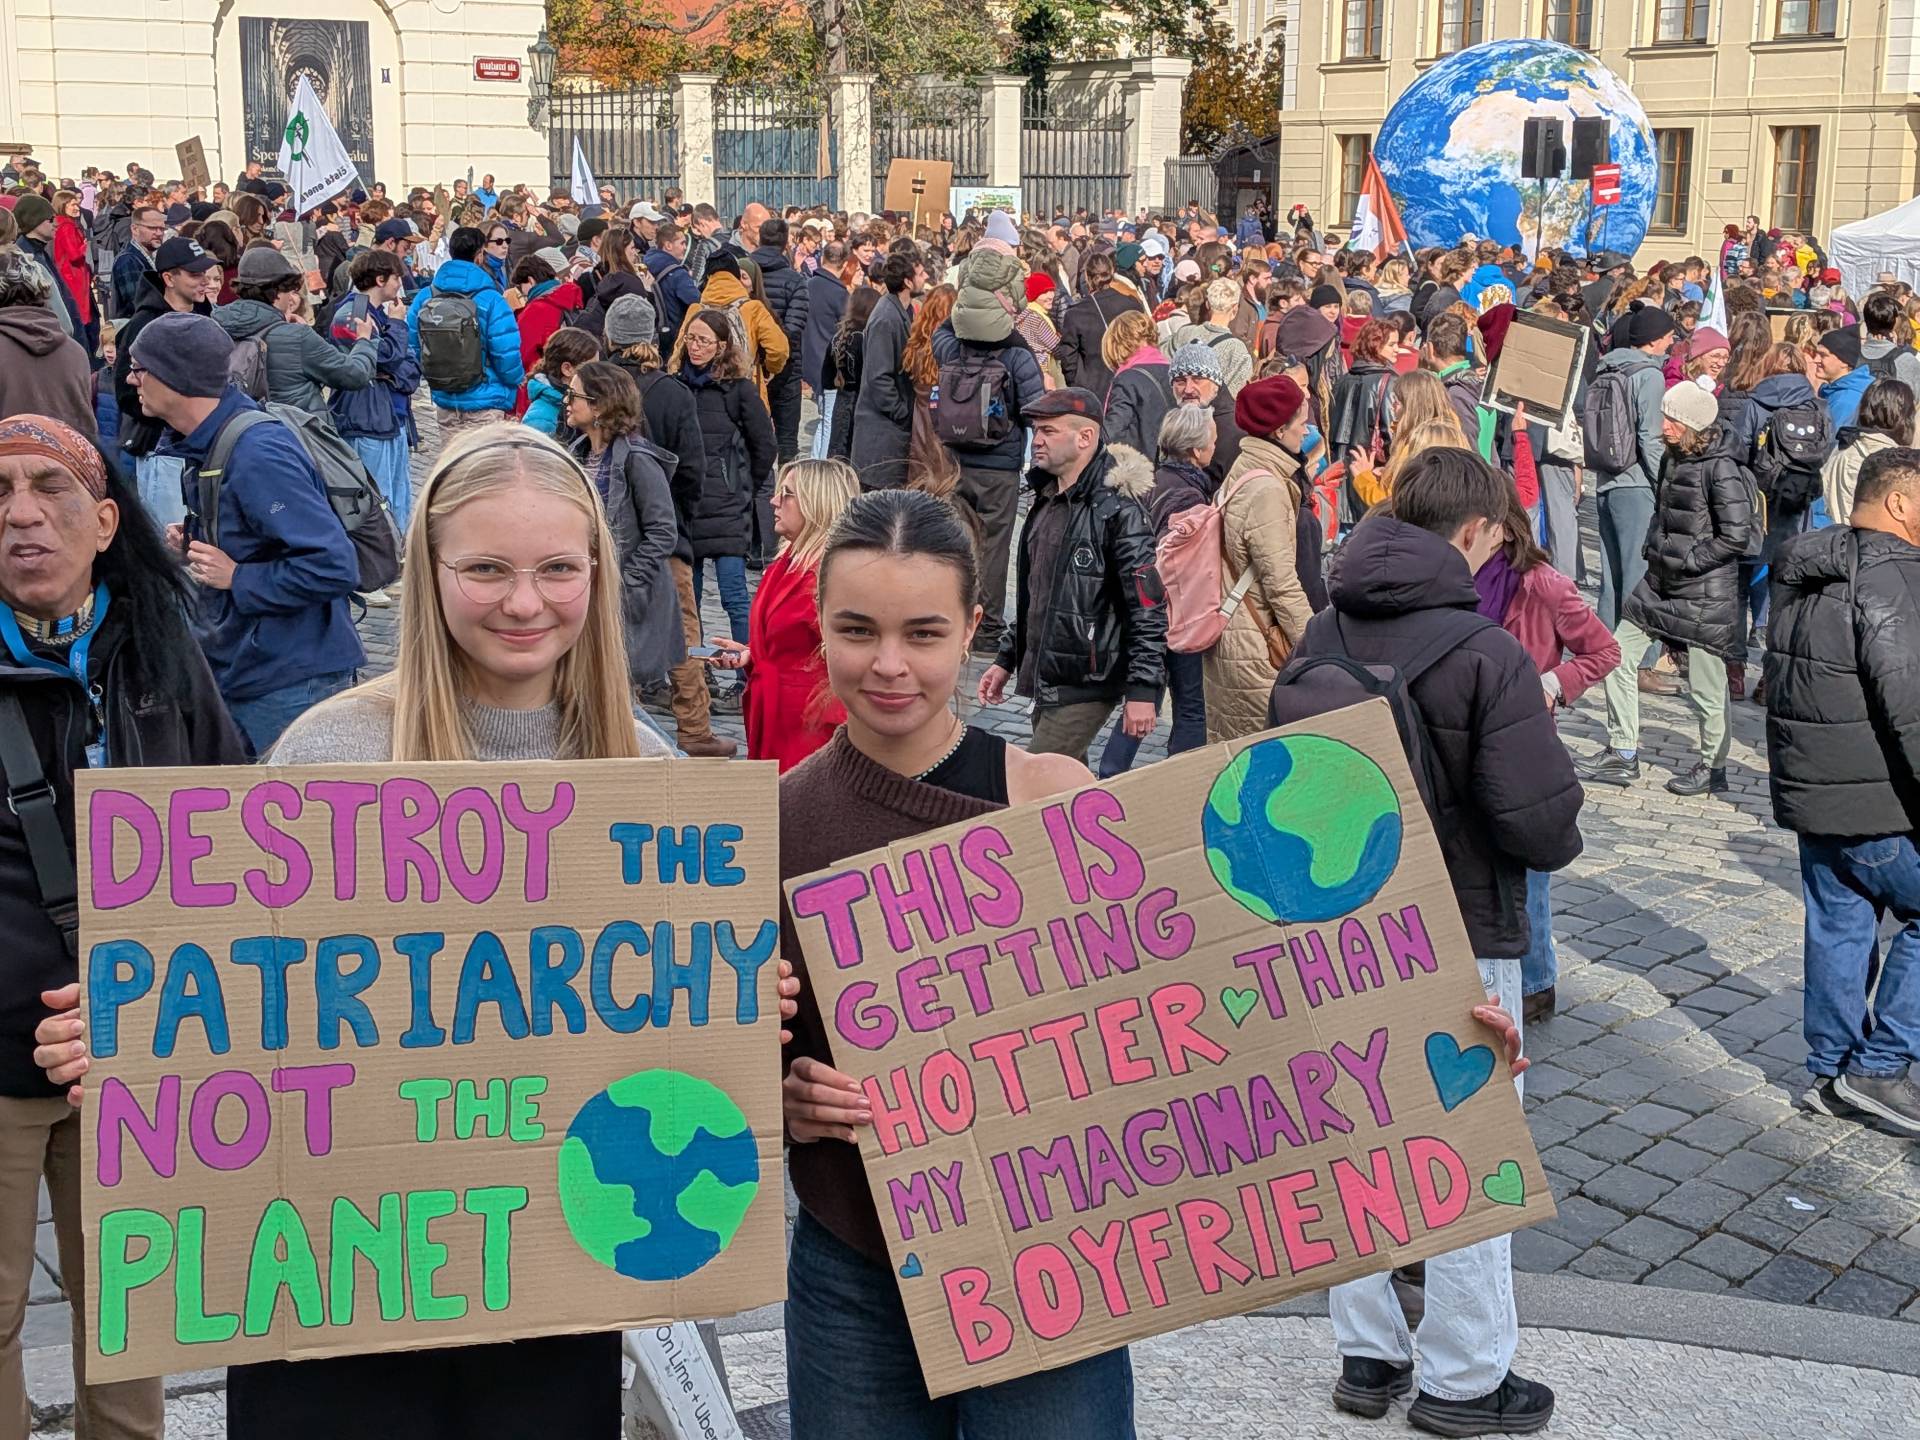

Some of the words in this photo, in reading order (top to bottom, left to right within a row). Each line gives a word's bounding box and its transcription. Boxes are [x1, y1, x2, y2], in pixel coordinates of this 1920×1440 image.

[89, 778, 575, 910] DESTROY
[609, 822, 746, 887] THE
[791, 825, 1023, 969] THIS
[1042, 788, 1145, 904] IS
[88, 919, 778, 1059] PATRIARCHY
[834, 887, 1196, 1050] GETTING
[861, 982, 1231, 1157] HOTTER
[1233, 904, 1438, 1020] THAN
[96, 1063, 355, 1187] NOT
[399, 1075, 548, 1142] THE
[887, 1161, 968, 1241] MY
[990, 1027, 1394, 1232] IMAGINARY
[98, 1186, 529, 1356] PLANET
[941, 1135, 1471, 1365] BOYFRIEND
[656, 1325, 675, 1354] On
[669, 1350, 694, 1393] Lime
